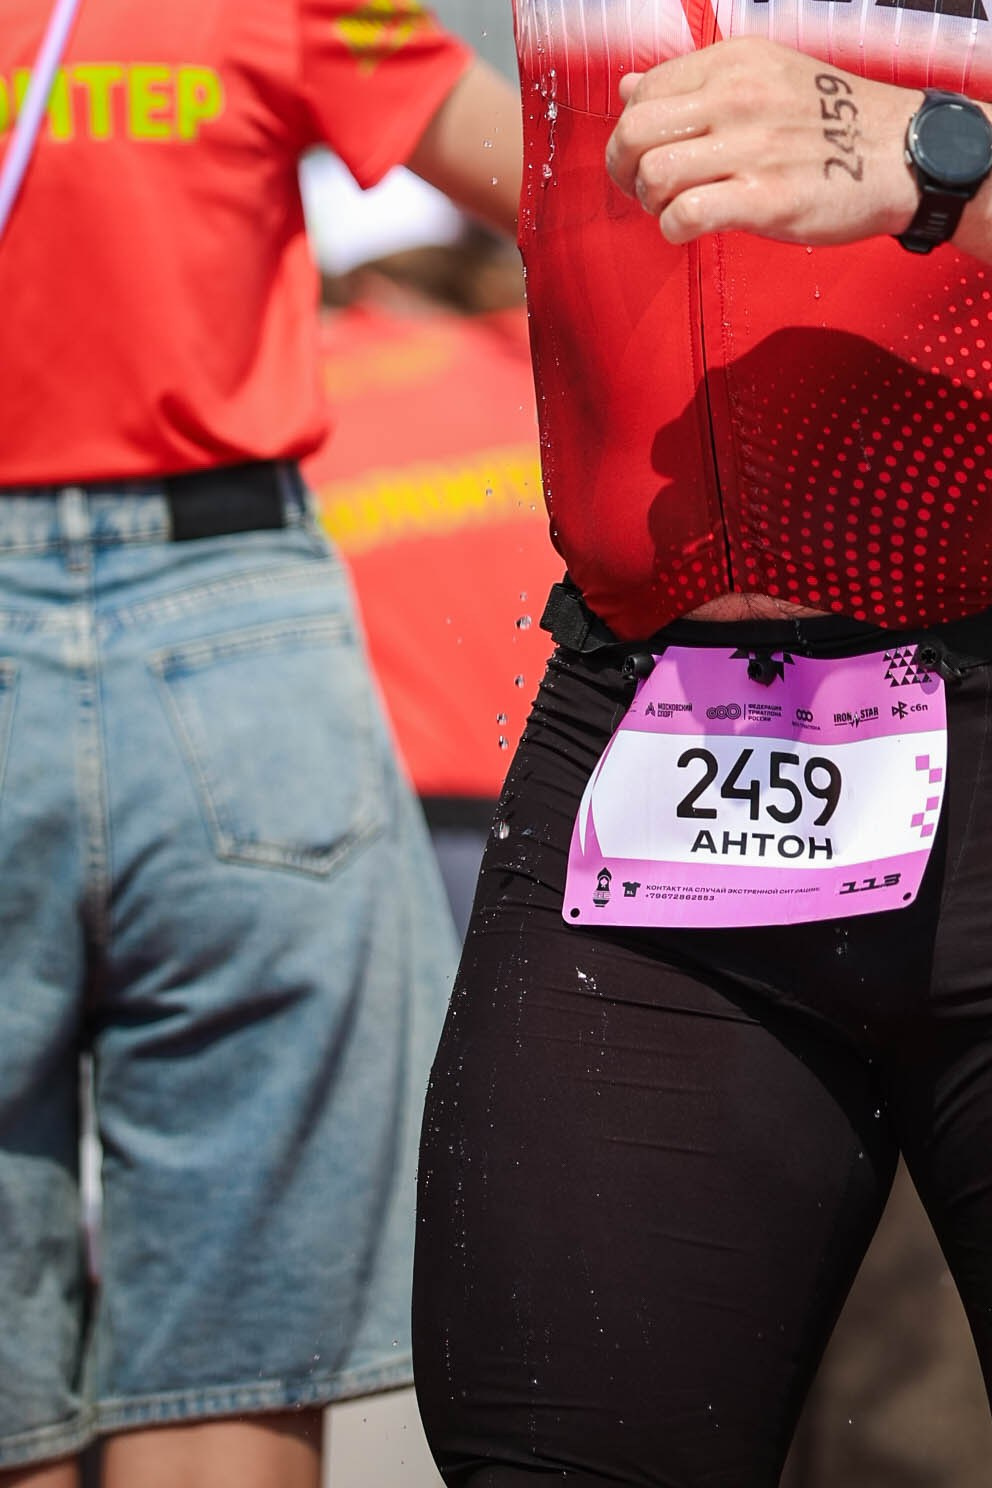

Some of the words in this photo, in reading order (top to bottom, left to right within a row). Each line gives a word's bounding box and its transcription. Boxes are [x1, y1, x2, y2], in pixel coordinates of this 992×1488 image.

[815, 73, 864, 182] 2459
[657, 702, 693, 712] МОСКОВСКИЙ
[748, 709, 782, 717] ТРИАТЛОНА
[910, 703, 929, 712] сбп
[657, 710, 674, 718] СПОРТ
[833, 712, 853, 723] IRON
[860, 706, 879, 719] STAR
[676, 747, 842, 827] 2459
[690, 829, 833, 860] АНТОН
[646, 884, 681, 892] КОНТАКТ
[840, 873, 901, 895] 113
